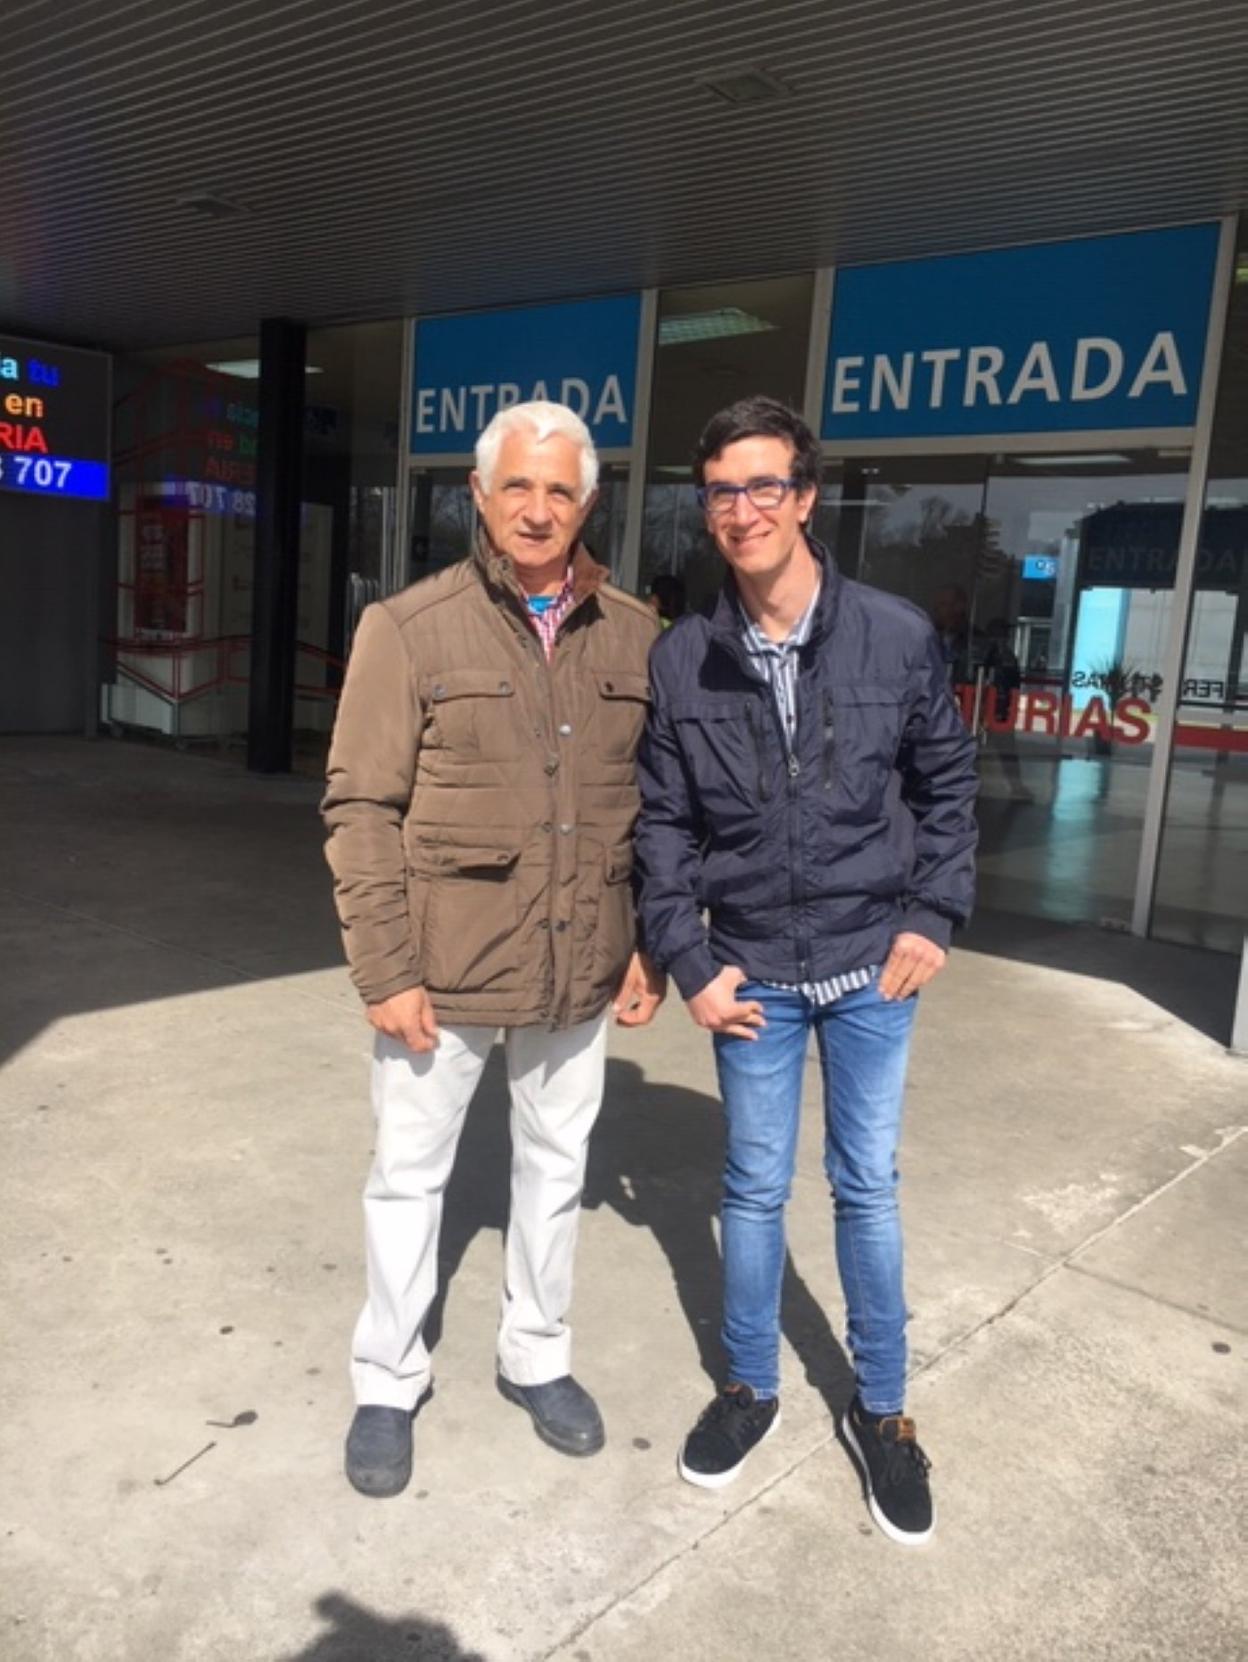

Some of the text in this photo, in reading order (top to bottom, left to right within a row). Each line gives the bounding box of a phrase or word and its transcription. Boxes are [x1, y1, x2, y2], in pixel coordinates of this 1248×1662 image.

[0, 356, 60, 387] a tu
[832, 331, 1188, 414] ENTRADA
[5, 393, 43, 418] en
[0, 421, 48, 453] RIA
[14, 455, 72, 488] 707
[953, 682, 1152, 746] TURIAS
